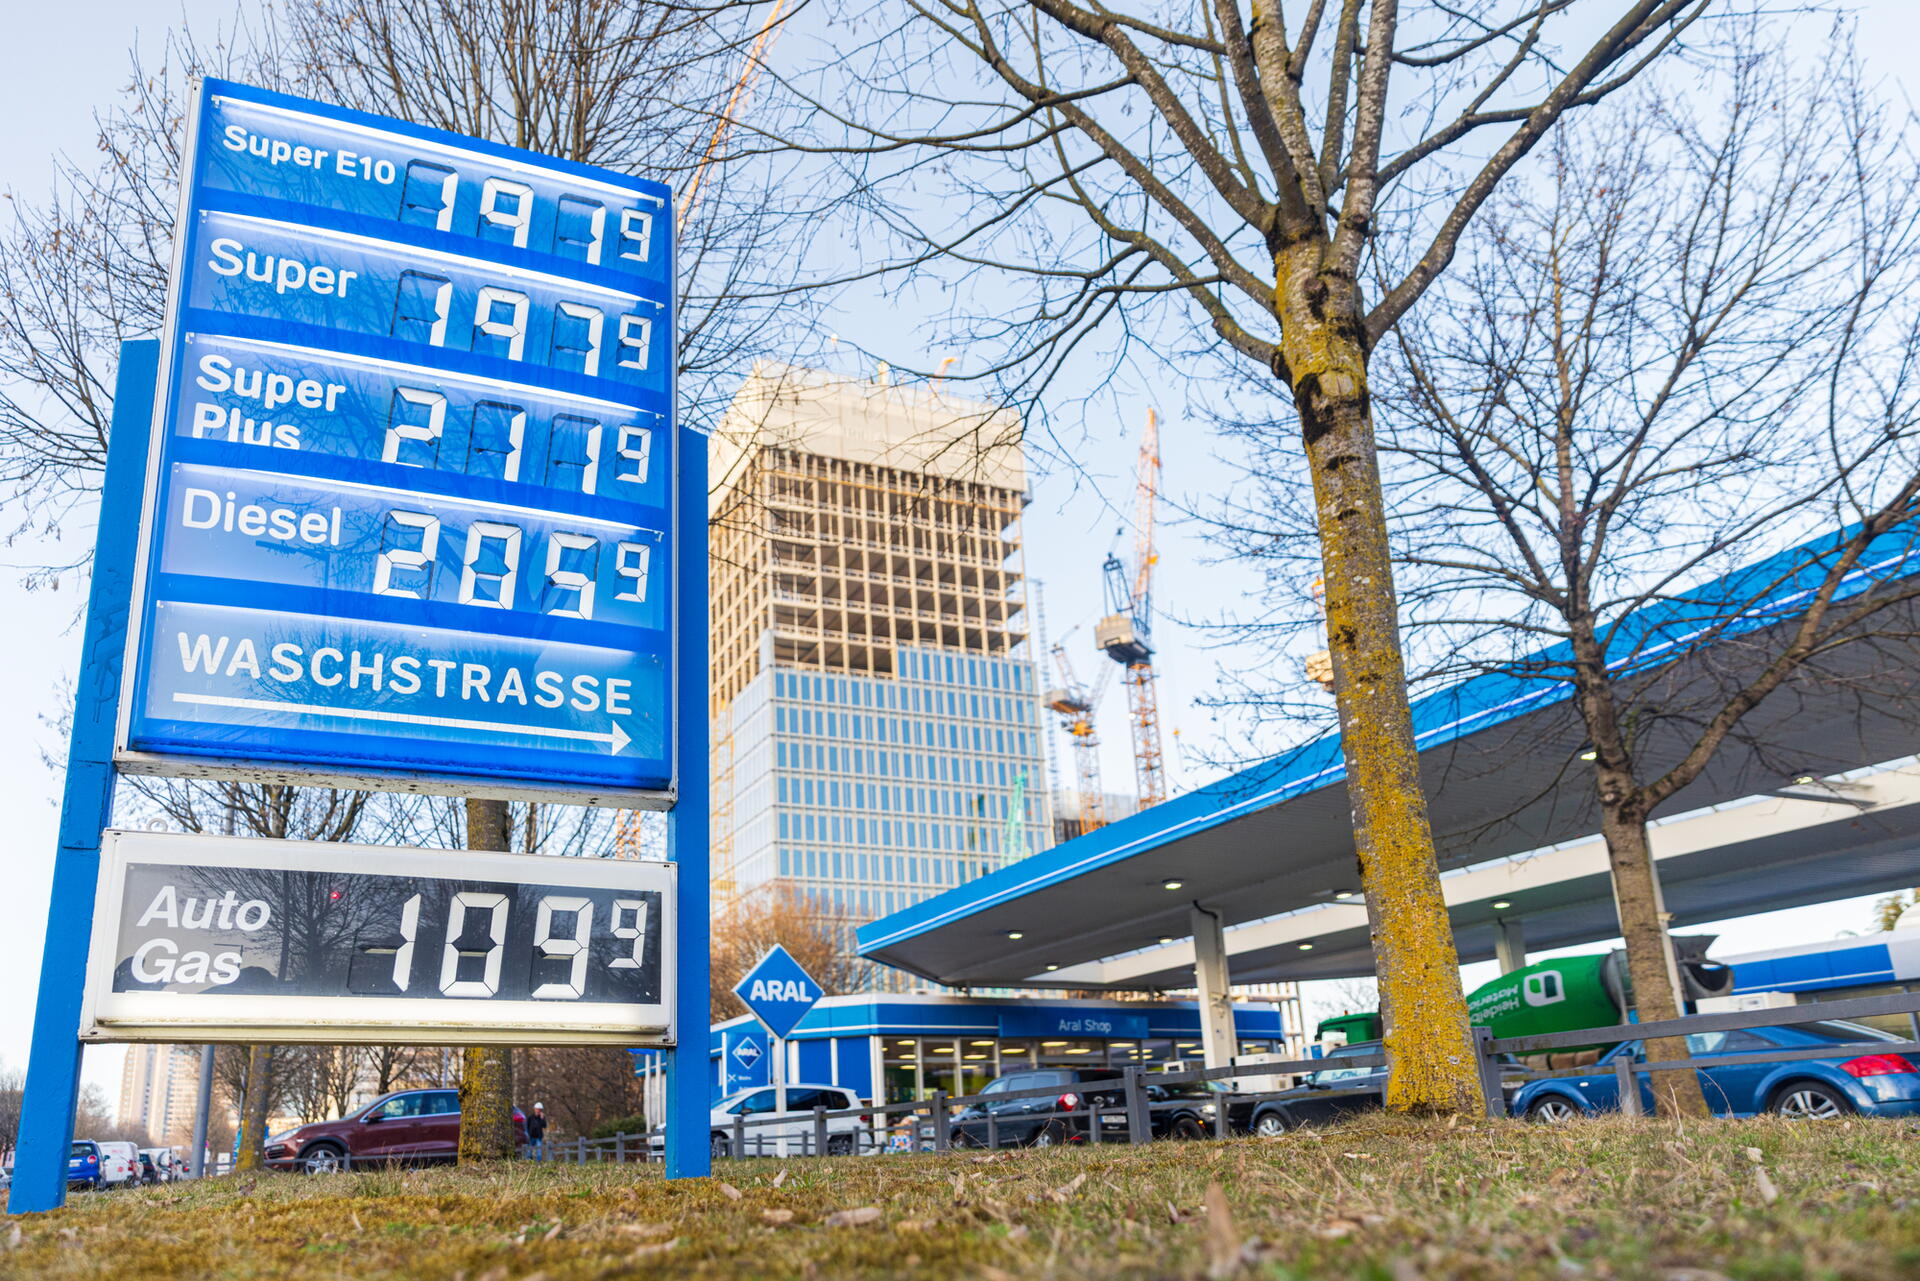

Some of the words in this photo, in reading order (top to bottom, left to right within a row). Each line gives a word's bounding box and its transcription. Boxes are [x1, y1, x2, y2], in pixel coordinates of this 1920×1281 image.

[223, 124, 328, 169] Super
[335, 149, 396, 185] E10
[207, 237, 357, 298] Super
[196, 354, 346, 412] Super
[192, 402, 301, 450] Plus
[182, 487, 341, 546] Diesel
[177, 631, 633, 715] WASCHSTRASSE
[136, 885, 271, 931] Auto
[131, 938, 243, 984] Gas
[750, 979, 813, 1002] ARAL
[1059, 1019, 1081, 1032] Aral
[1084, 1019, 1112, 1034] Shop
